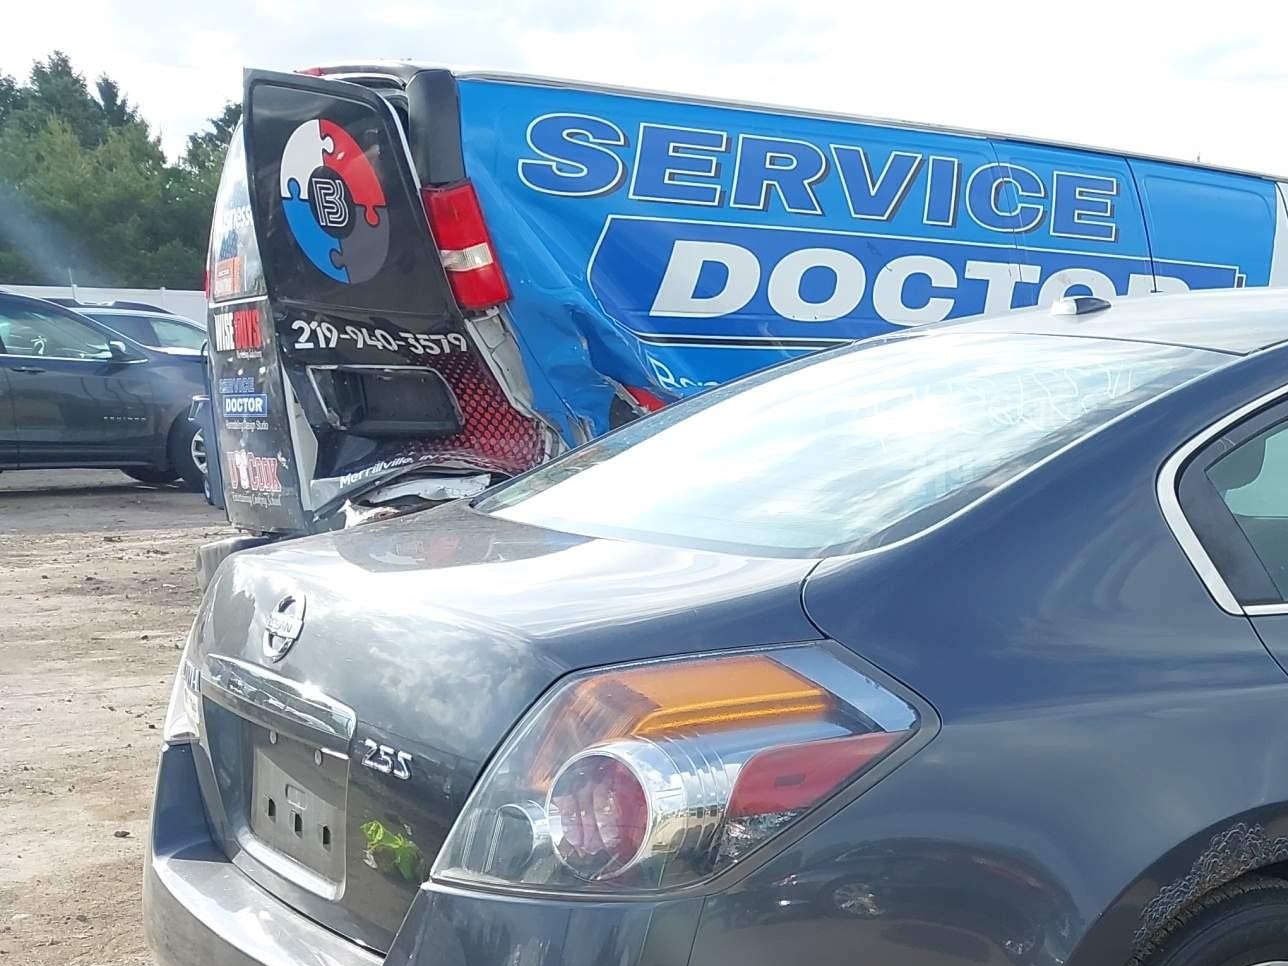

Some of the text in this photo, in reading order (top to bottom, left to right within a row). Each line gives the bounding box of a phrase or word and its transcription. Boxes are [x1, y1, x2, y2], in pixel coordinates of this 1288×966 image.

[518, 112, 1120, 245] SERVICE
[291, 320, 468, 355] 219-940-3579
[225, 397, 263, 413] DOCTOR
